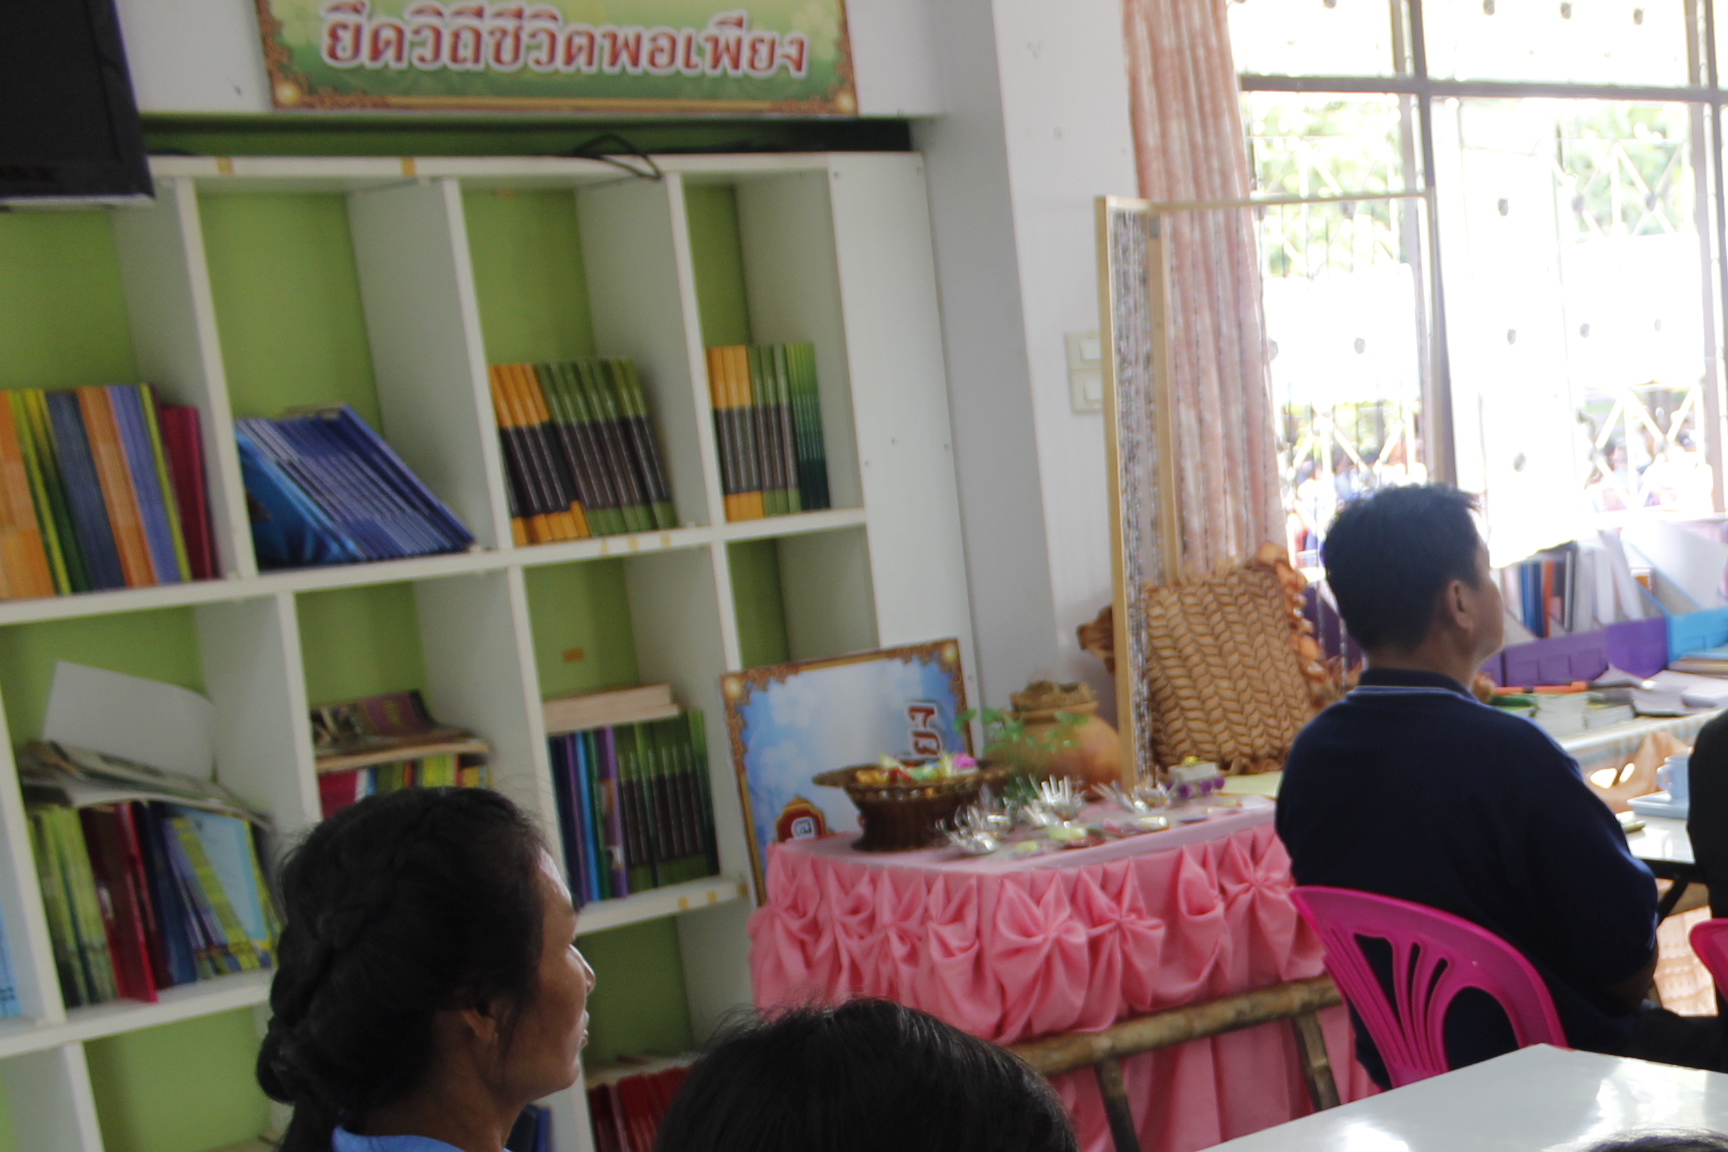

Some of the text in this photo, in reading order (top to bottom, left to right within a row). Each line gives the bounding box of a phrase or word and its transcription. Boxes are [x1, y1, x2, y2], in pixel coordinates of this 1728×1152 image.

[322, 0, 809, 76] ยึดวิถีชีวิตพอเพียง
